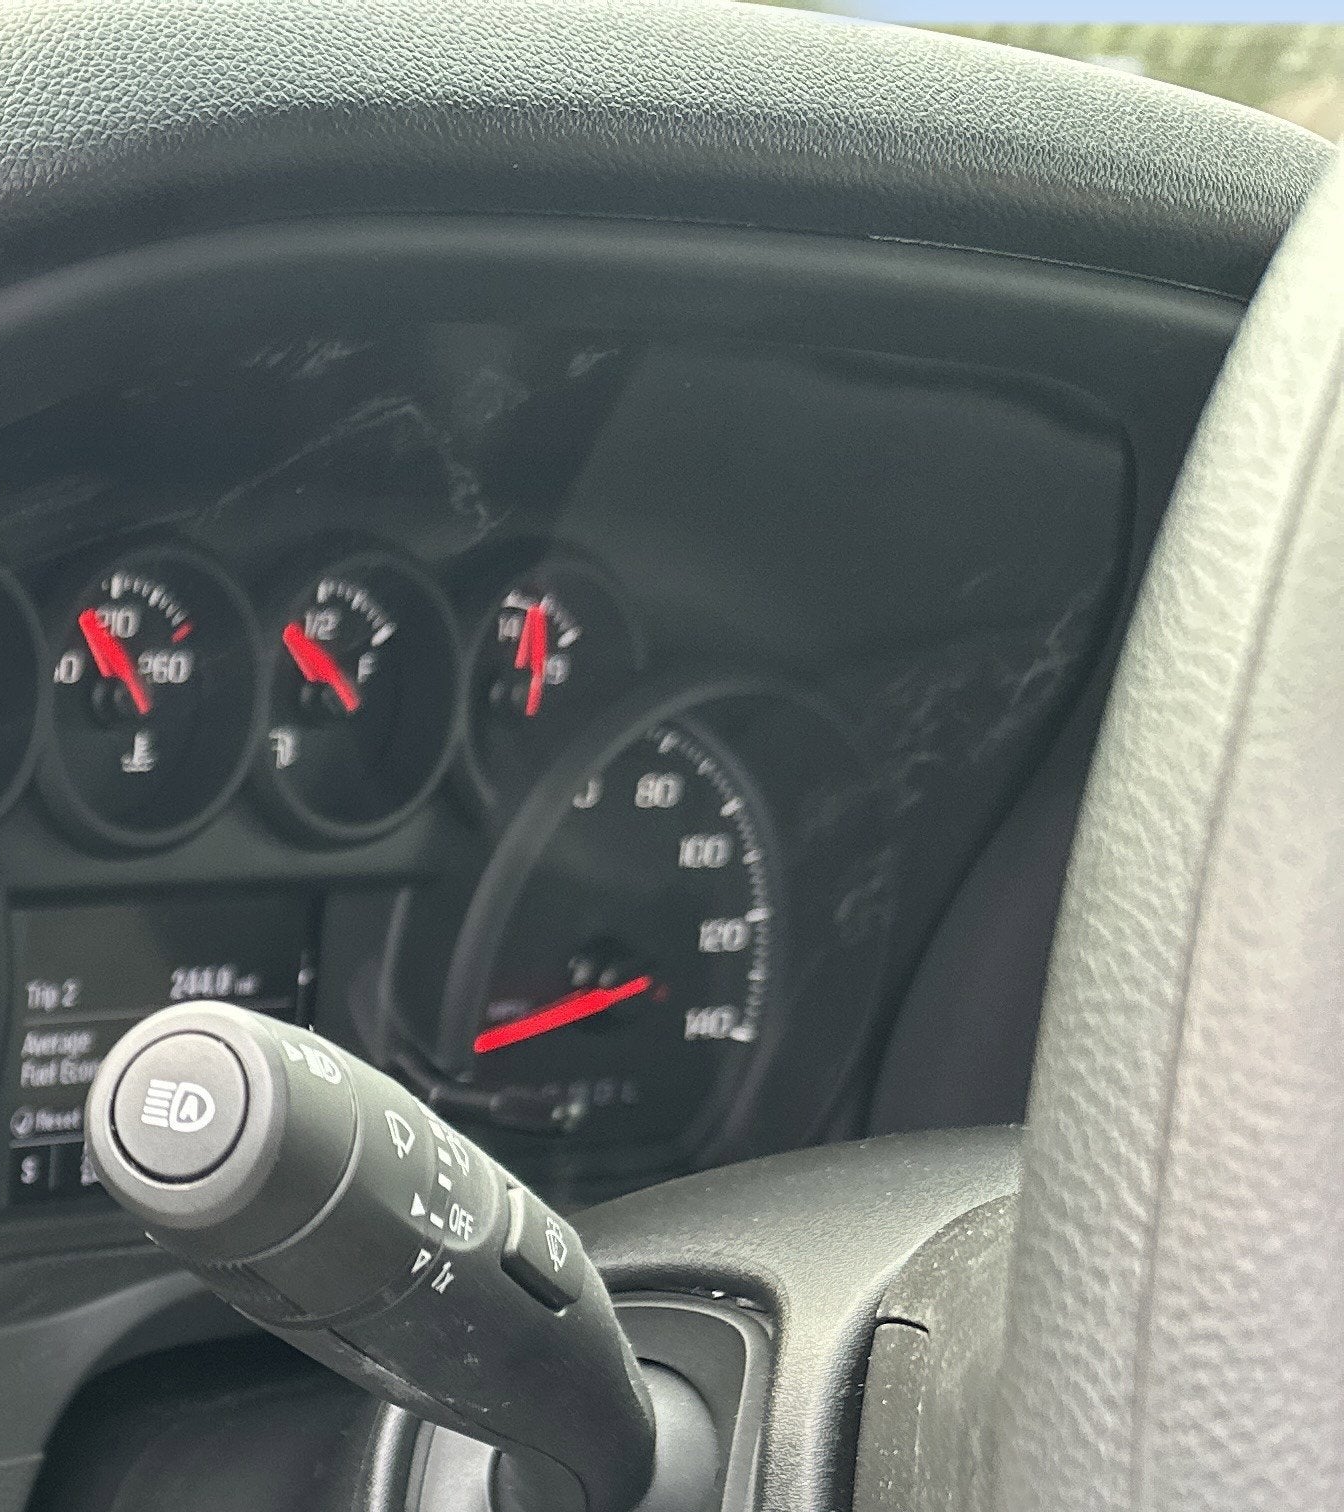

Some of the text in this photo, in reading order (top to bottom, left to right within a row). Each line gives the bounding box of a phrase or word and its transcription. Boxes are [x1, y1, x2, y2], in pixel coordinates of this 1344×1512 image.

[634, 770, 686, 809] 80
[678, 833, 733, 869] 100
[698, 917, 751, 952] 120
[25, 978, 81, 1012] Trip 2
[684, 1005, 740, 1041] 140
[21, 1030, 95, 1060] Average
[20, 1058, 58, 1088] Fuel
[448, 1203, 474, 1242] OFF
